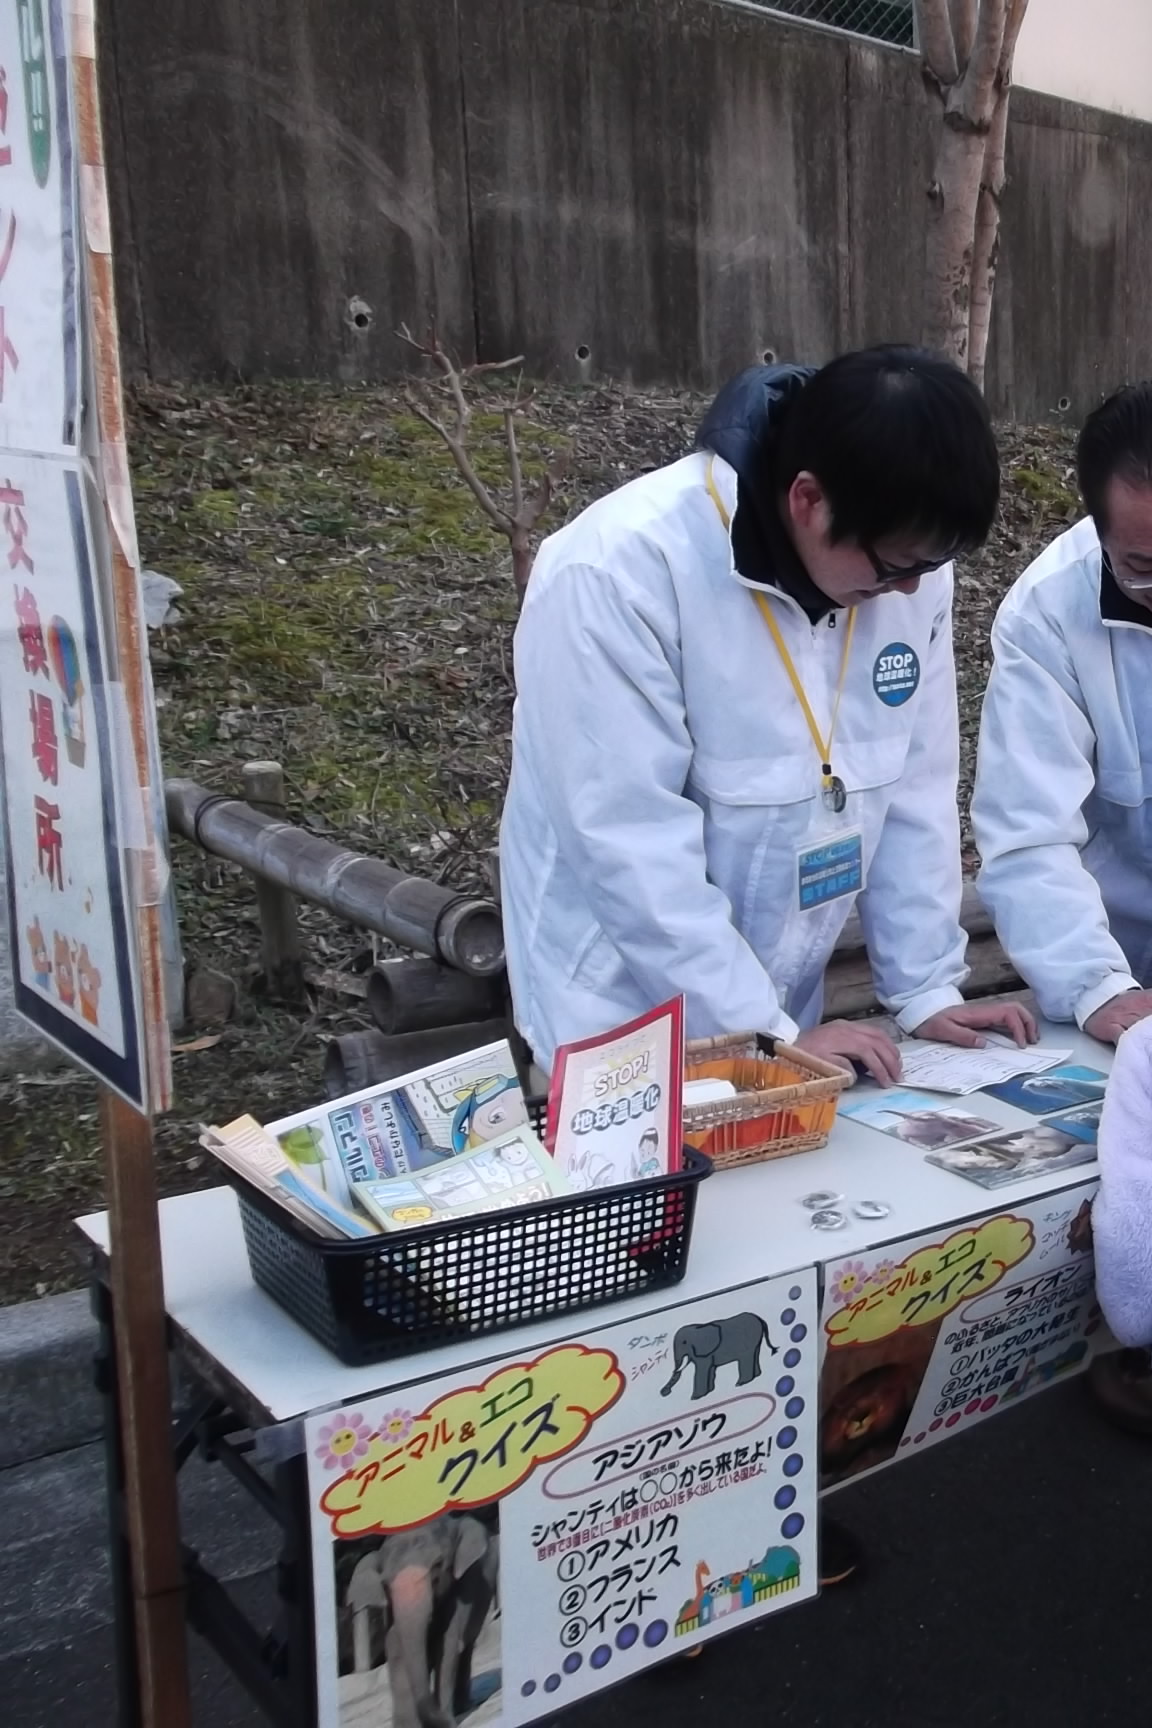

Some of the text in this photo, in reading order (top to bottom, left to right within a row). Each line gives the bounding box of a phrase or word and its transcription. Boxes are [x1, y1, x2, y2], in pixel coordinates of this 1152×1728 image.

[879, 653, 913, 672] STOP
[593, 1050, 650, 1097] STOP!
[901, 1251, 992, 1323] クイズ
[1004, 1264, 1082, 1306] ライオン
[437, 1393, 561, 1496] クイズ
[592, 1412, 727, 1482] アジアゾウ
